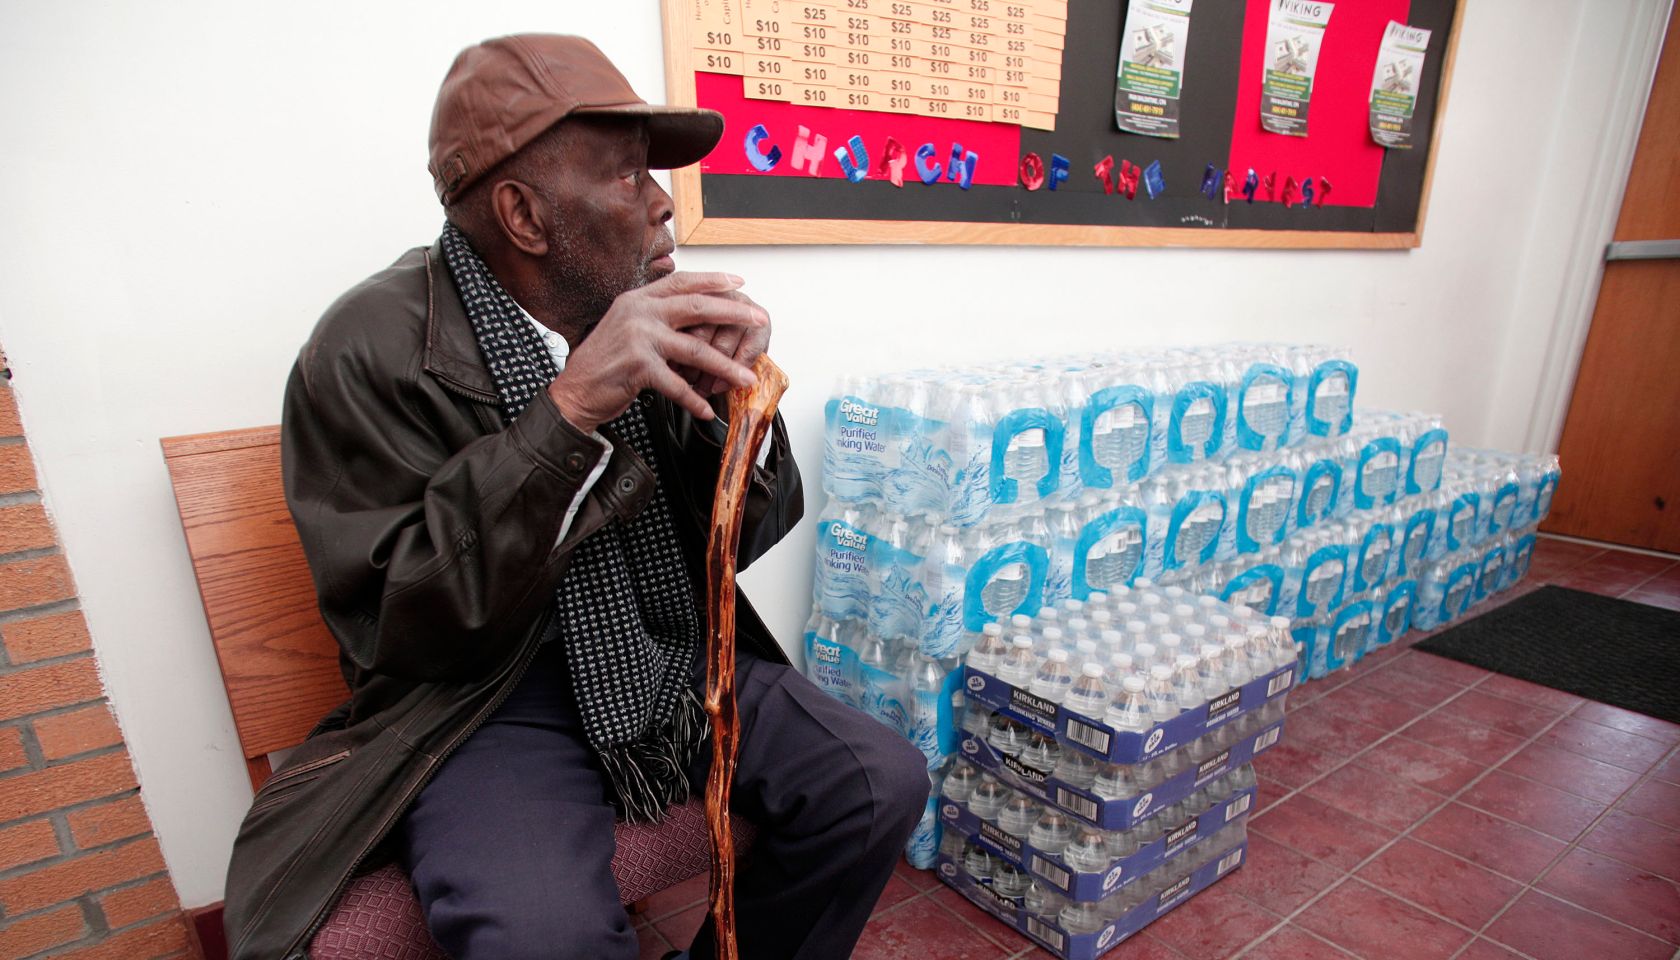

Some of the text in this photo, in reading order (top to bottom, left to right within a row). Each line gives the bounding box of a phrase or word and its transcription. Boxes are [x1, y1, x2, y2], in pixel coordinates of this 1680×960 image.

[892, 3, 912, 16] $25
[971, 0, 989, 12] $25
[1007, 6, 1025, 18] $25
[1278, 0, 1321, 17] VIKING
[804, 7, 827, 21] $25
[932, 10, 951, 23] $25
[756, 19, 780, 33] $10
[848, 18, 869, 31] $25
[891, 21, 912, 34] $25
[971, 17, 989, 29] $25
[1007, 23, 1025, 35] $25
[707, 32, 732, 46] $10
[804, 27, 826, 39] $10
[848, 33, 869, 46] $10
[932, 27, 951, 40] $25
[970, 33, 988, 46] $25
[757, 38, 781, 51] $10
[891, 39, 911, 51] $10
[931, 44, 950, 57] $10
[1008, 40, 1026, 52] $25
[804, 45, 826, 58] $10
[969, 50, 988, 63] $10
[707, 55, 731, 69] $10
[848, 52, 869, 65] $10
[891, 56, 912, 68] $10
[1006, 56, 1024, 68] $10
[758, 61, 781, 74] $10
[930, 62, 949, 74] $10
[968, 67, 986, 79] $10
[805, 68, 827, 81] $10
[849, 74, 870, 87] $10
[1006, 71, 1024, 82] $10
[759, 83, 782, 96] $10
[891, 80, 911, 91] $10
[930, 84, 949, 96] $10
[804, 89, 826, 102] $10
[848, 93, 869, 105] $10
[968, 88, 986, 99] $10
[1003, 91, 1021, 102] $10
[890, 98, 910, 109] $10
[929, 101, 948, 113] $10
[966, 105, 984, 117] $10
[1002, 109, 1020, 120] $10
[743, 123, 978, 191] CHURCH
[1020, 152, 1071, 191] OF
[1094, 154, 1167, 200] THE
[840, 399, 880, 418] Great
[846, 412, 878, 426] Value
[841, 427, 876, 441] Purified
[837, 440, 862, 452] nking
[831, 523, 867, 544] Great
[837, 536, 866, 551] Value
[831, 549, 865, 564] Purified
[1013, 690, 1056, 714] KIRKLAND
[1210, 691, 1240, 712] KIRKLAND
[982, 822, 1021, 848] KIRKLAND
[1167, 820, 1197, 844] KIRKLAND
